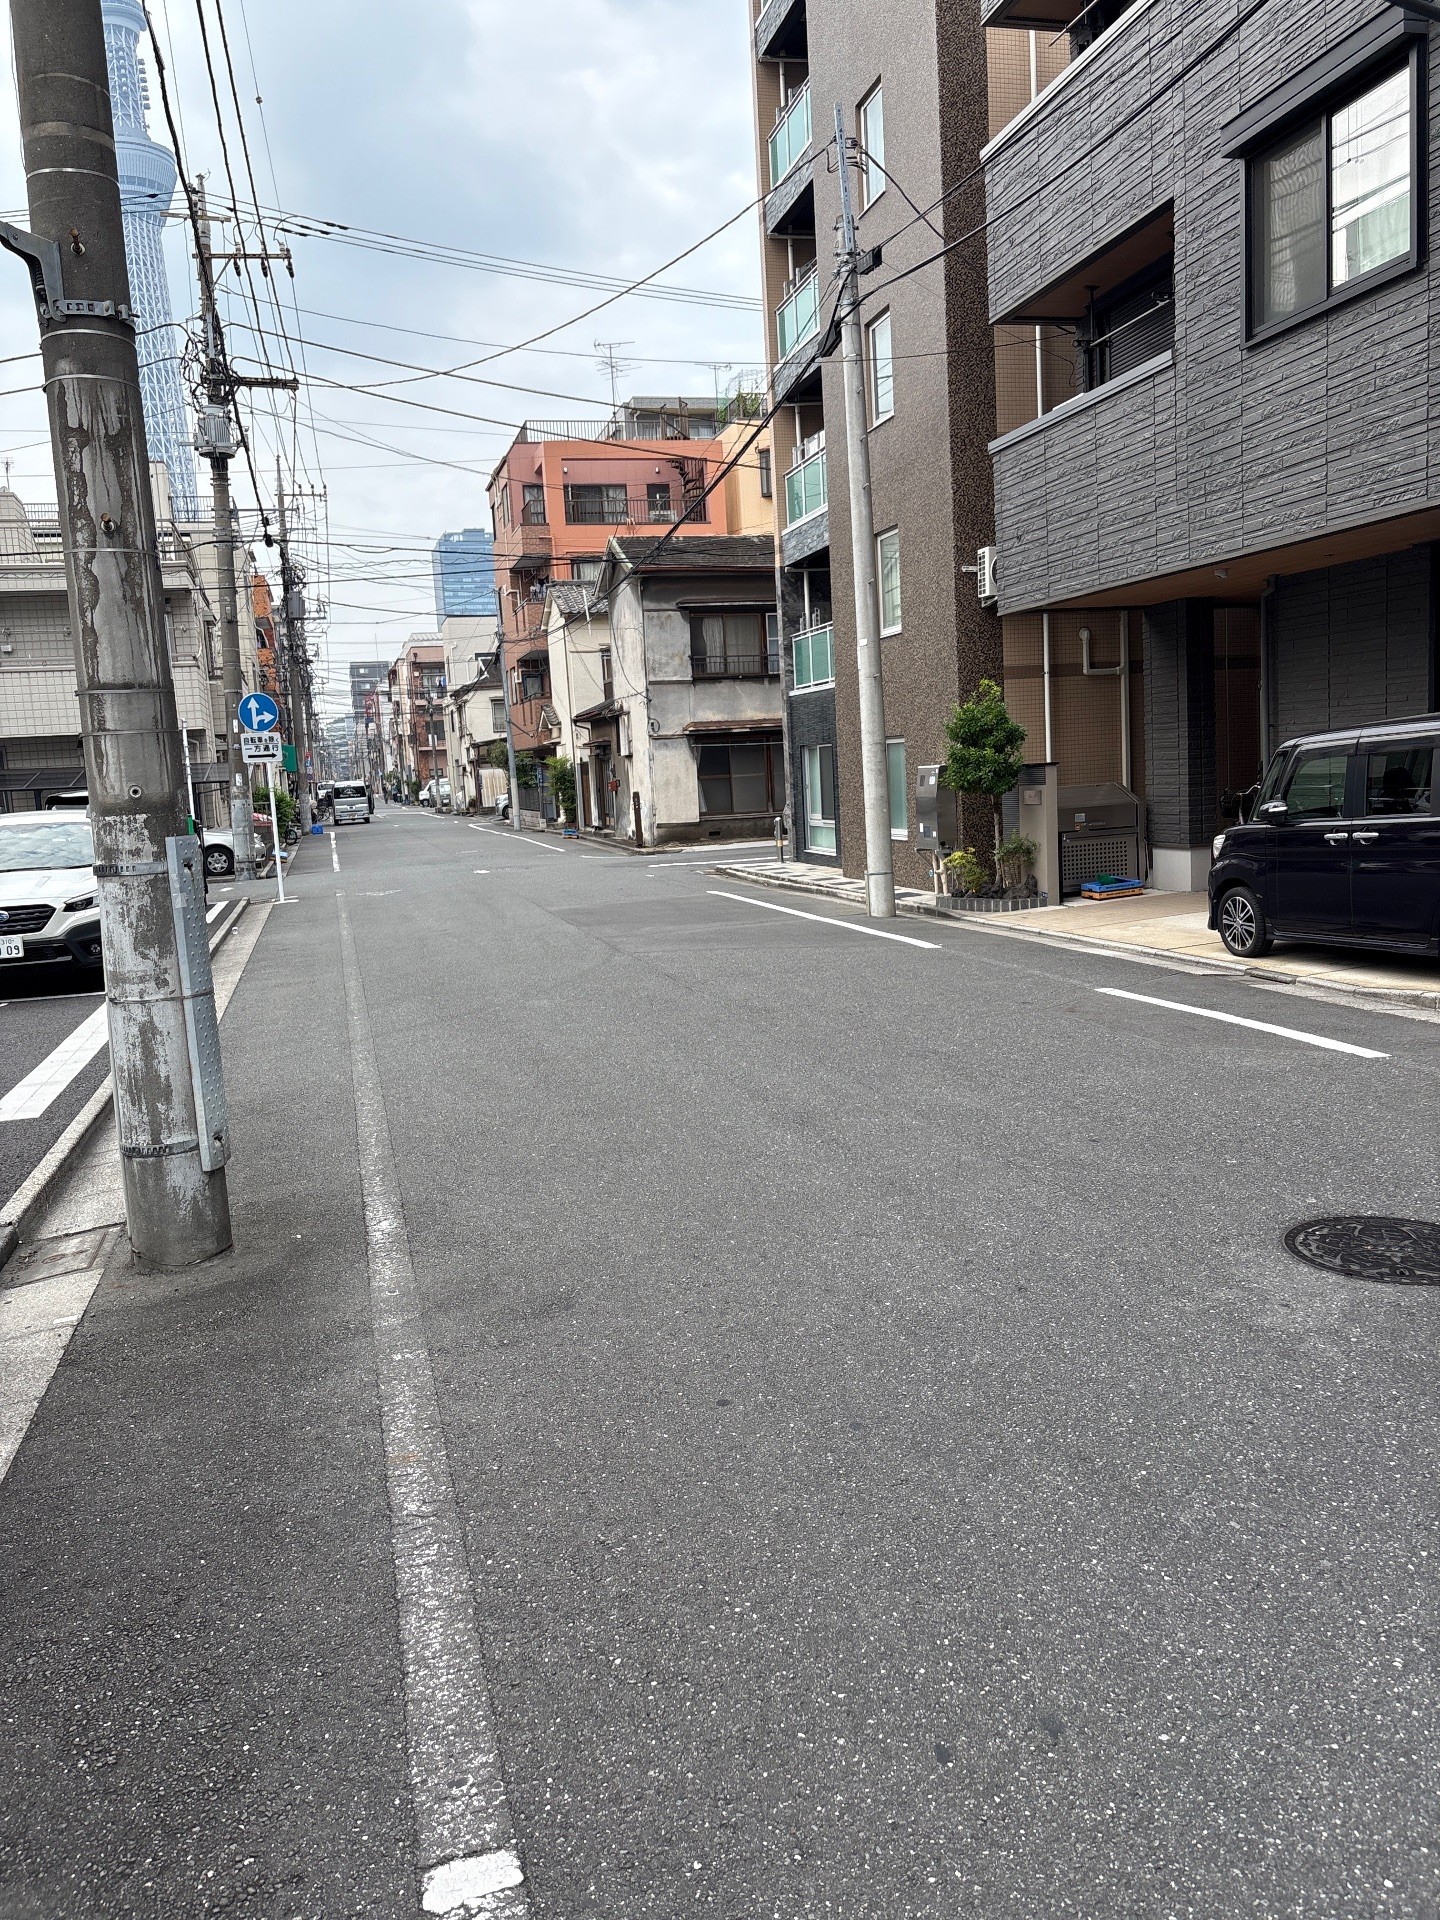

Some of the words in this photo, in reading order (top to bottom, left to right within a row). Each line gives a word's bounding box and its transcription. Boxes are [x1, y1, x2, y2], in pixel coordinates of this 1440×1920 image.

[243, 735, 279, 744] 自転車を除く
[244, 744, 279, 752] 一方通行
[0, 945, 20, 955] 09
